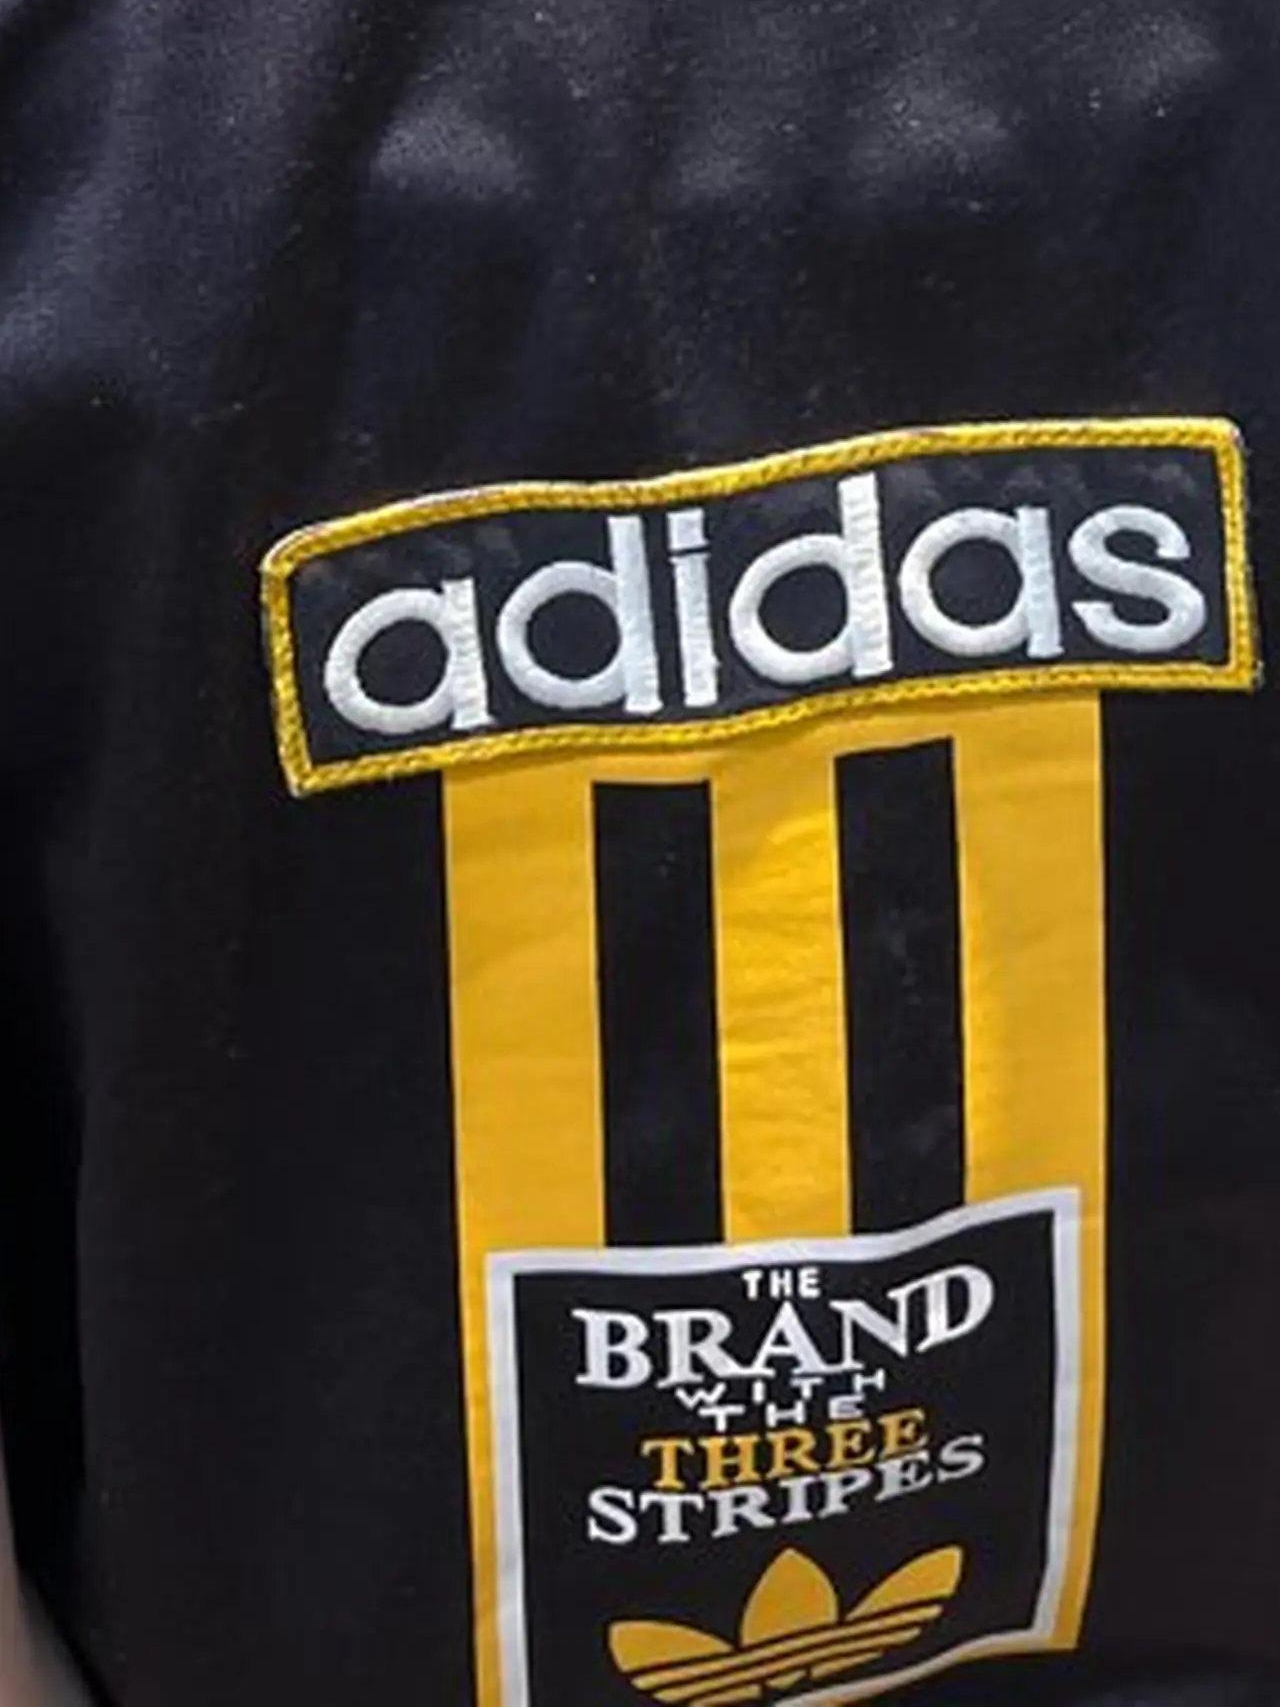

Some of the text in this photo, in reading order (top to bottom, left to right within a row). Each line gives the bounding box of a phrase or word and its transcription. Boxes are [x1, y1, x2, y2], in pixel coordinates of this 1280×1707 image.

[323, 471, 1207, 735] adidas
[742, 1267, 820, 1300] THE
[572, 1264, 994, 1389] BRAND
[675, 1369, 885, 1409] WITH
[699, 1394, 868, 1431] THE
[587, 1435, 985, 1544] STRIPES
[641, 1408, 928, 1490] THREE
